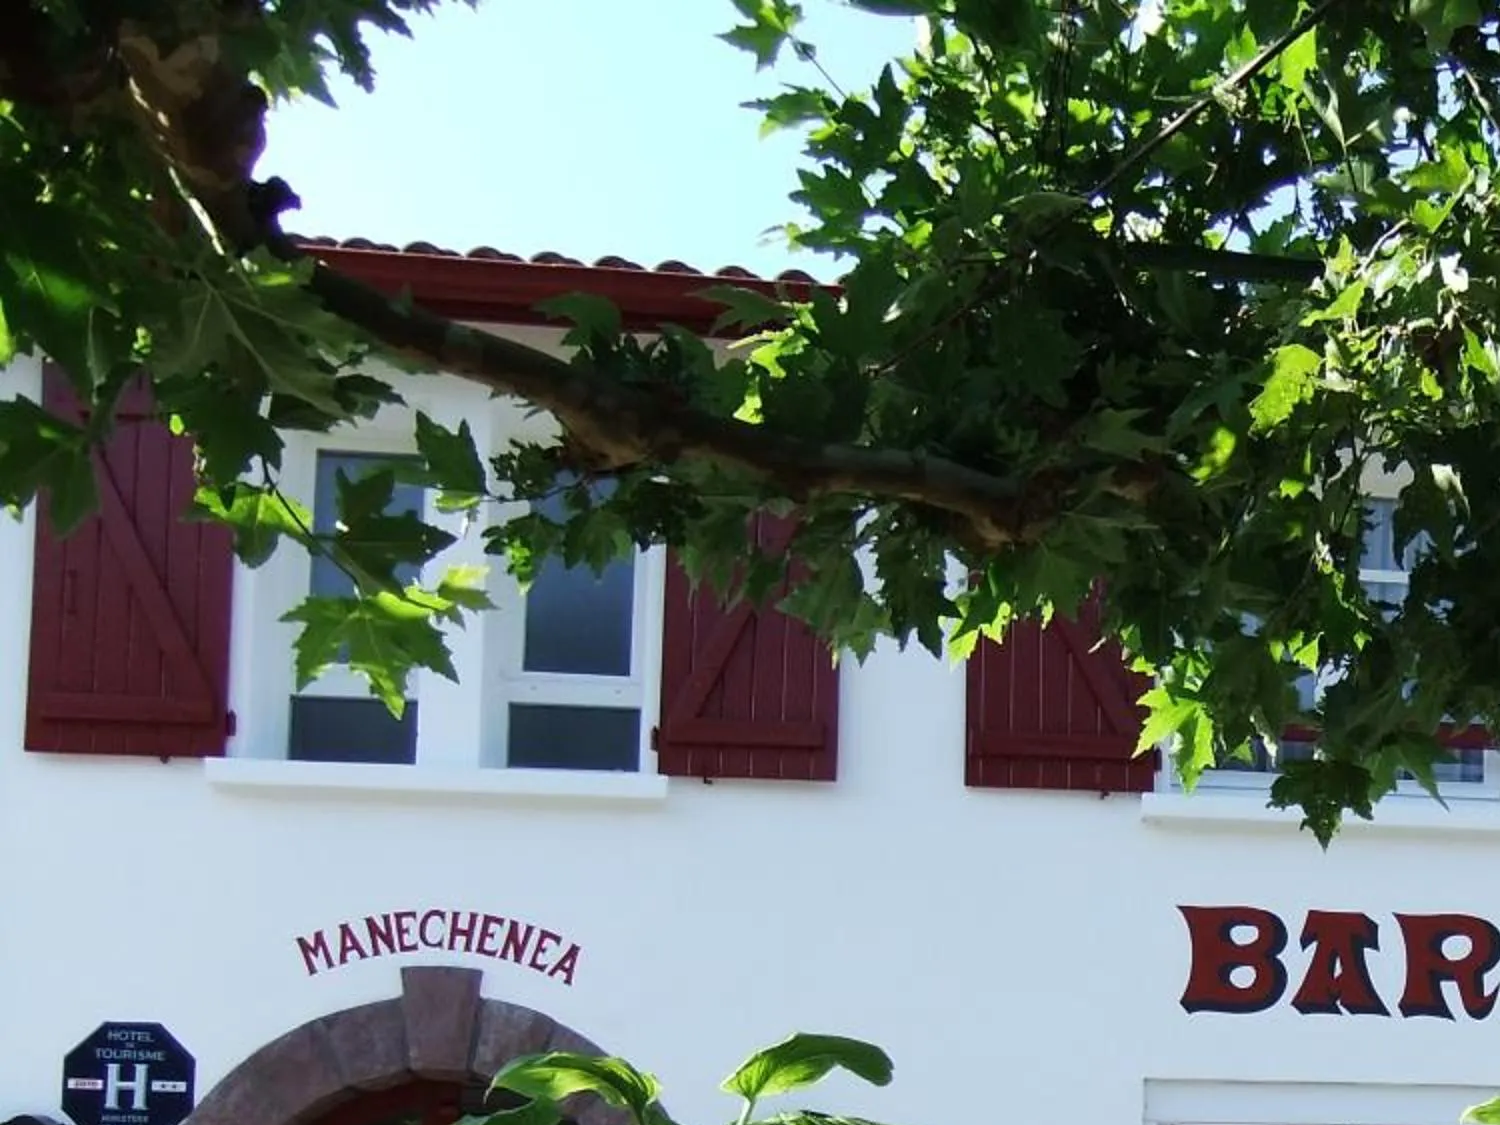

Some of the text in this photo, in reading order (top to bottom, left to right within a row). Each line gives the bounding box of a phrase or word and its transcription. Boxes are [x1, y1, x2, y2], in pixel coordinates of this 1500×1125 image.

[296, 909, 581, 986] MANECHENEA
[107, 1030, 154, 1042] HOTEL
[95, 1048, 165, 1061] TOURISME
[104, 1063, 149, 1110] H
